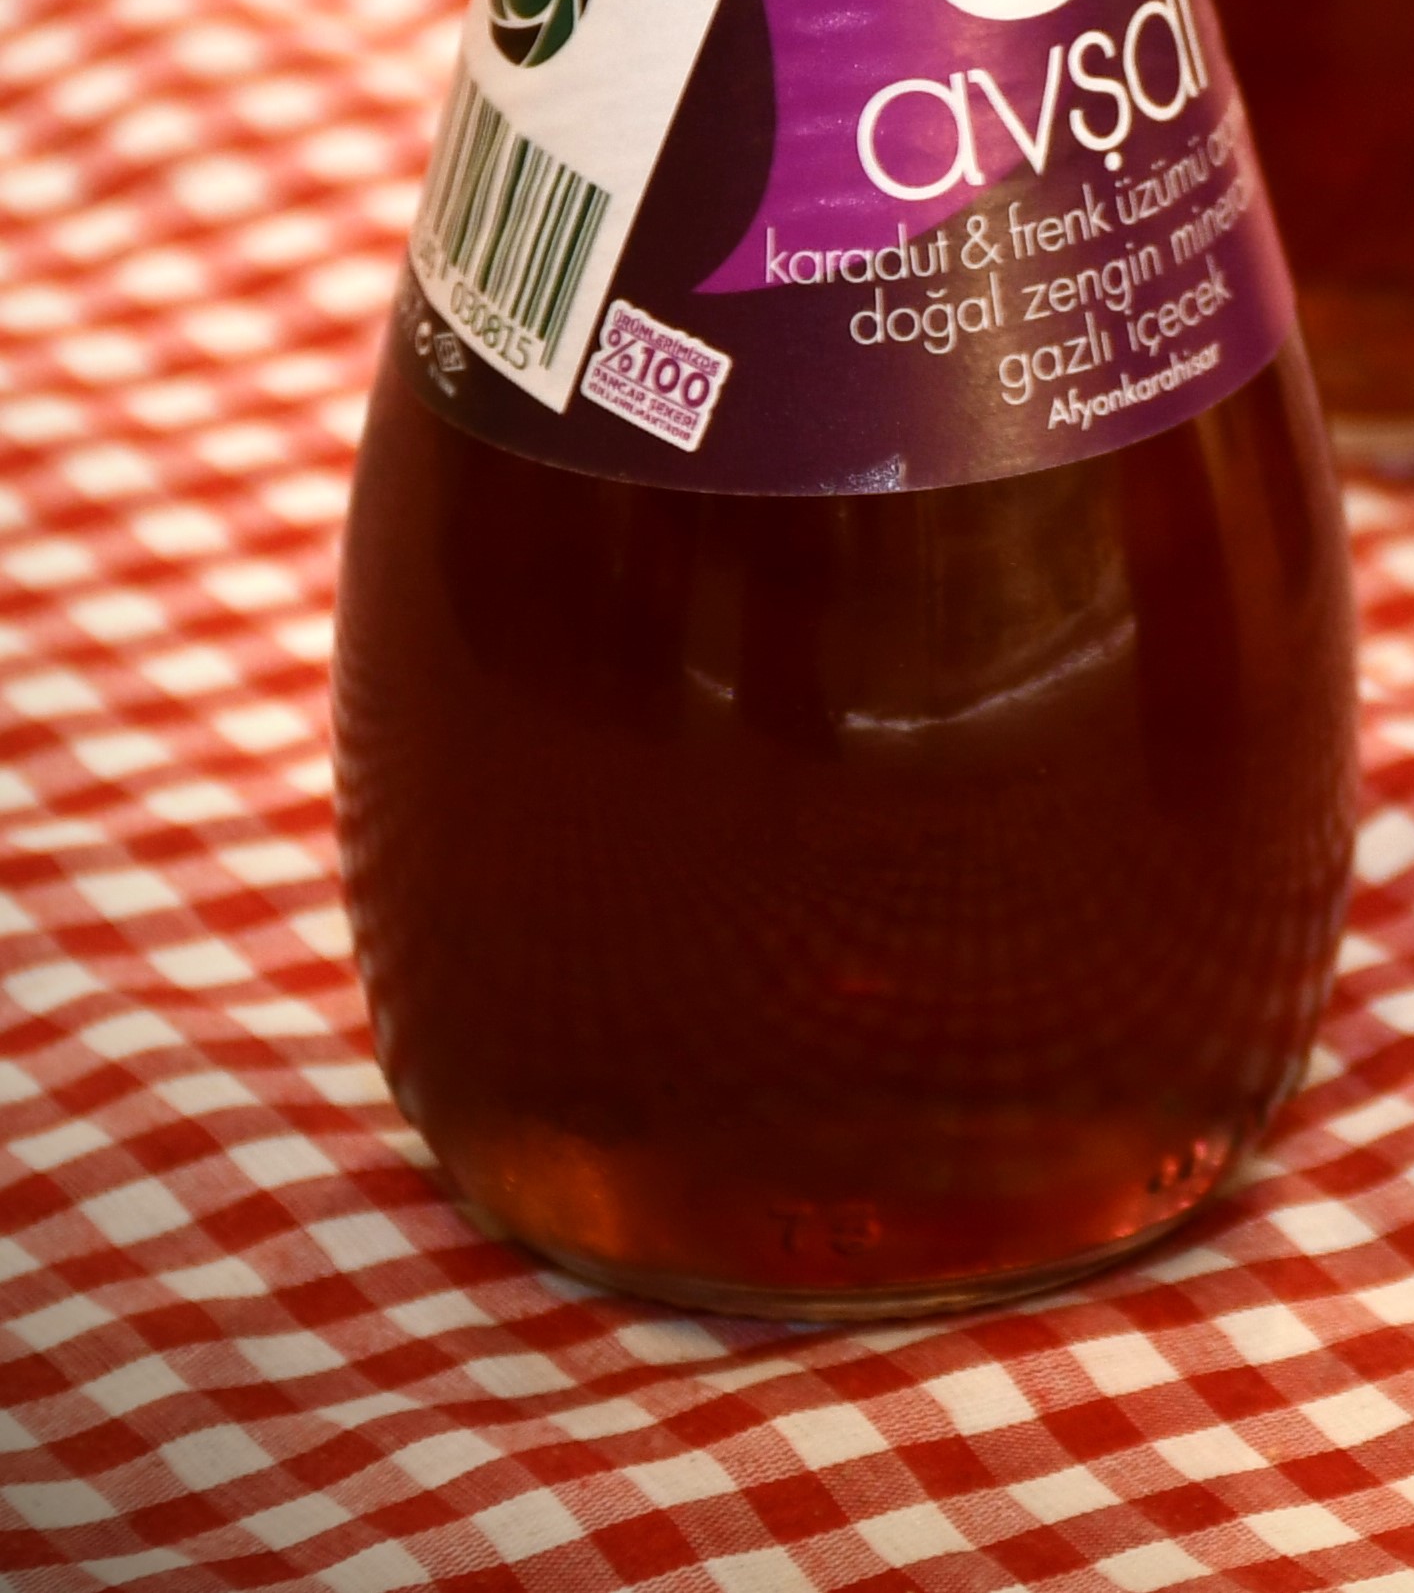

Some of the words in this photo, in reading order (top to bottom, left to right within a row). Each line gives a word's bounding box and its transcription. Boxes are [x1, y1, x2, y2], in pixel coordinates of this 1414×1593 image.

[765, 222, 949, 285] karadut
[961, 215, 1003, 272] &
[1008, 183, 1113, 261] frenk
[1117, 135, 1209, 225] üzümü
[450, 280, 533, 371] 030815
[849, 273, 1002, 354] doğal
[1022, 243, 1163, 322] zengin
[999, 312, 1113, 406] gazlı
[1127, 255, 1233, 354] içecek
[600, 327, 710, 409] %100
[1047, 342, 1221, 431] Afyonkarahisar
